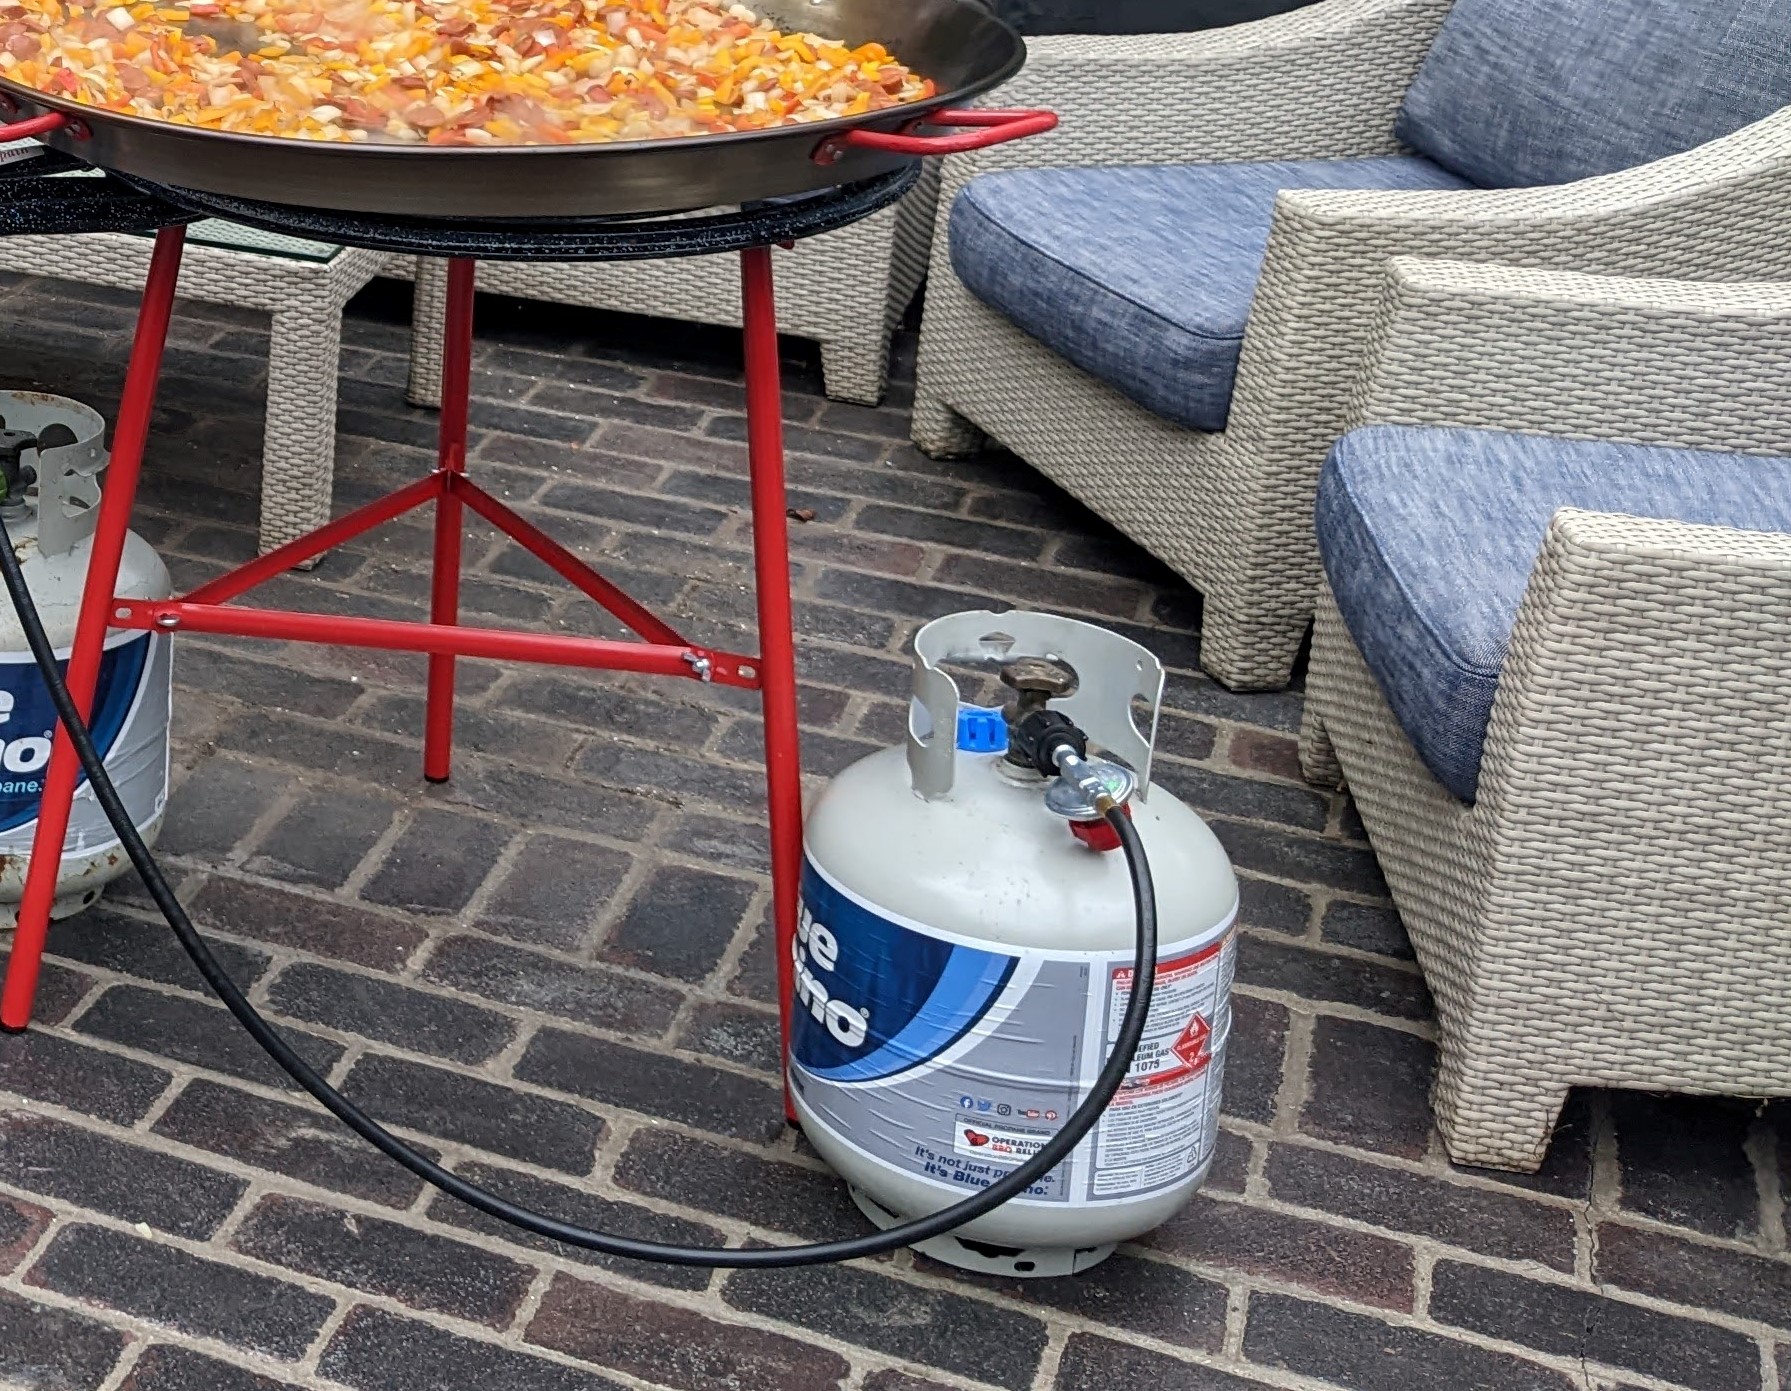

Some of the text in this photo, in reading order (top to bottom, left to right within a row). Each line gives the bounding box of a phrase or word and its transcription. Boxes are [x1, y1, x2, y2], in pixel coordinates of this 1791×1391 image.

[797, 893, 838, 972] ue
[1155, 1048, 1169, 1058] GAS
[915, 1146, 935, 1160] It's
[938, 1153, 963, 1168] not
[963, 1161, 991, 1176] just
[924, 1161, 949, 1178] It's
[953, 1171, 990, 1187] Blue
